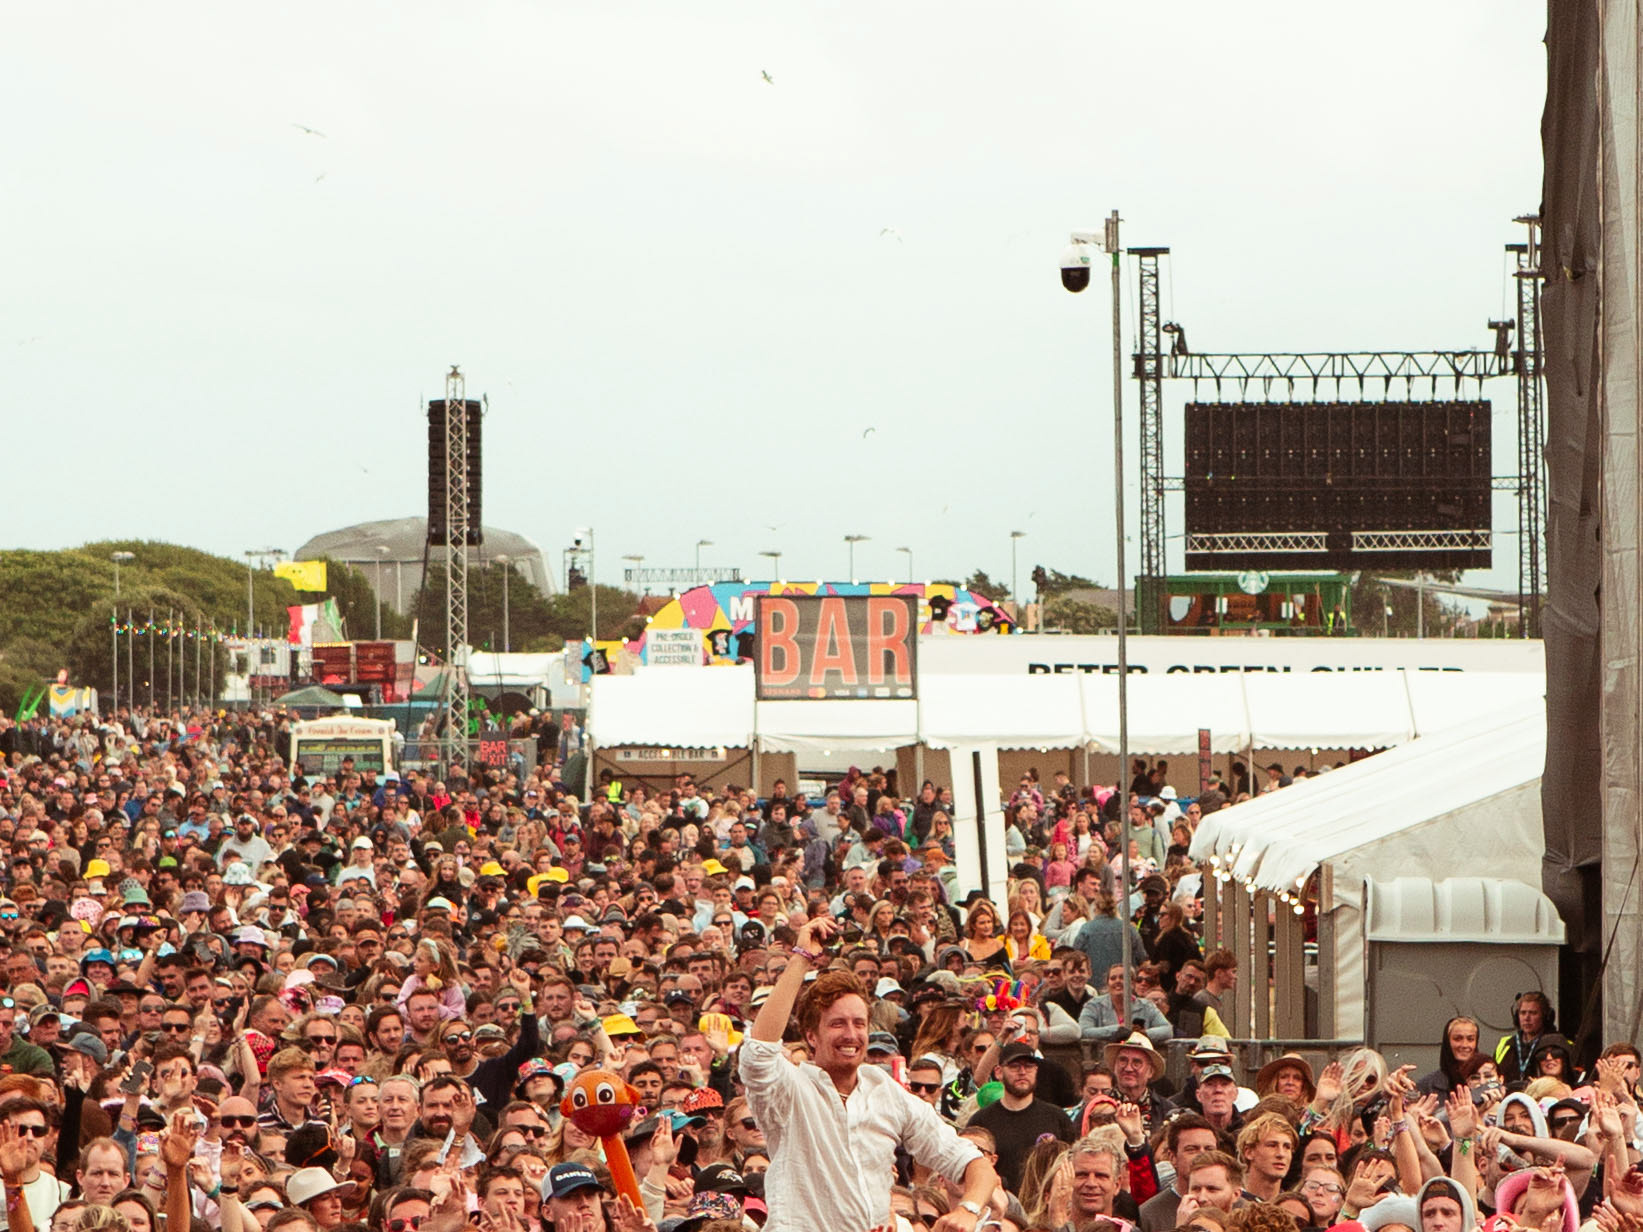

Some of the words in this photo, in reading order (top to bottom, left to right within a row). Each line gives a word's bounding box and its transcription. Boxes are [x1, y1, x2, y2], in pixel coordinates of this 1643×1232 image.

[760, 597, 912, 685] BAR
[480, 741, 507, 754] BAR
[638, 749, 686, 759] ACCESBLE
